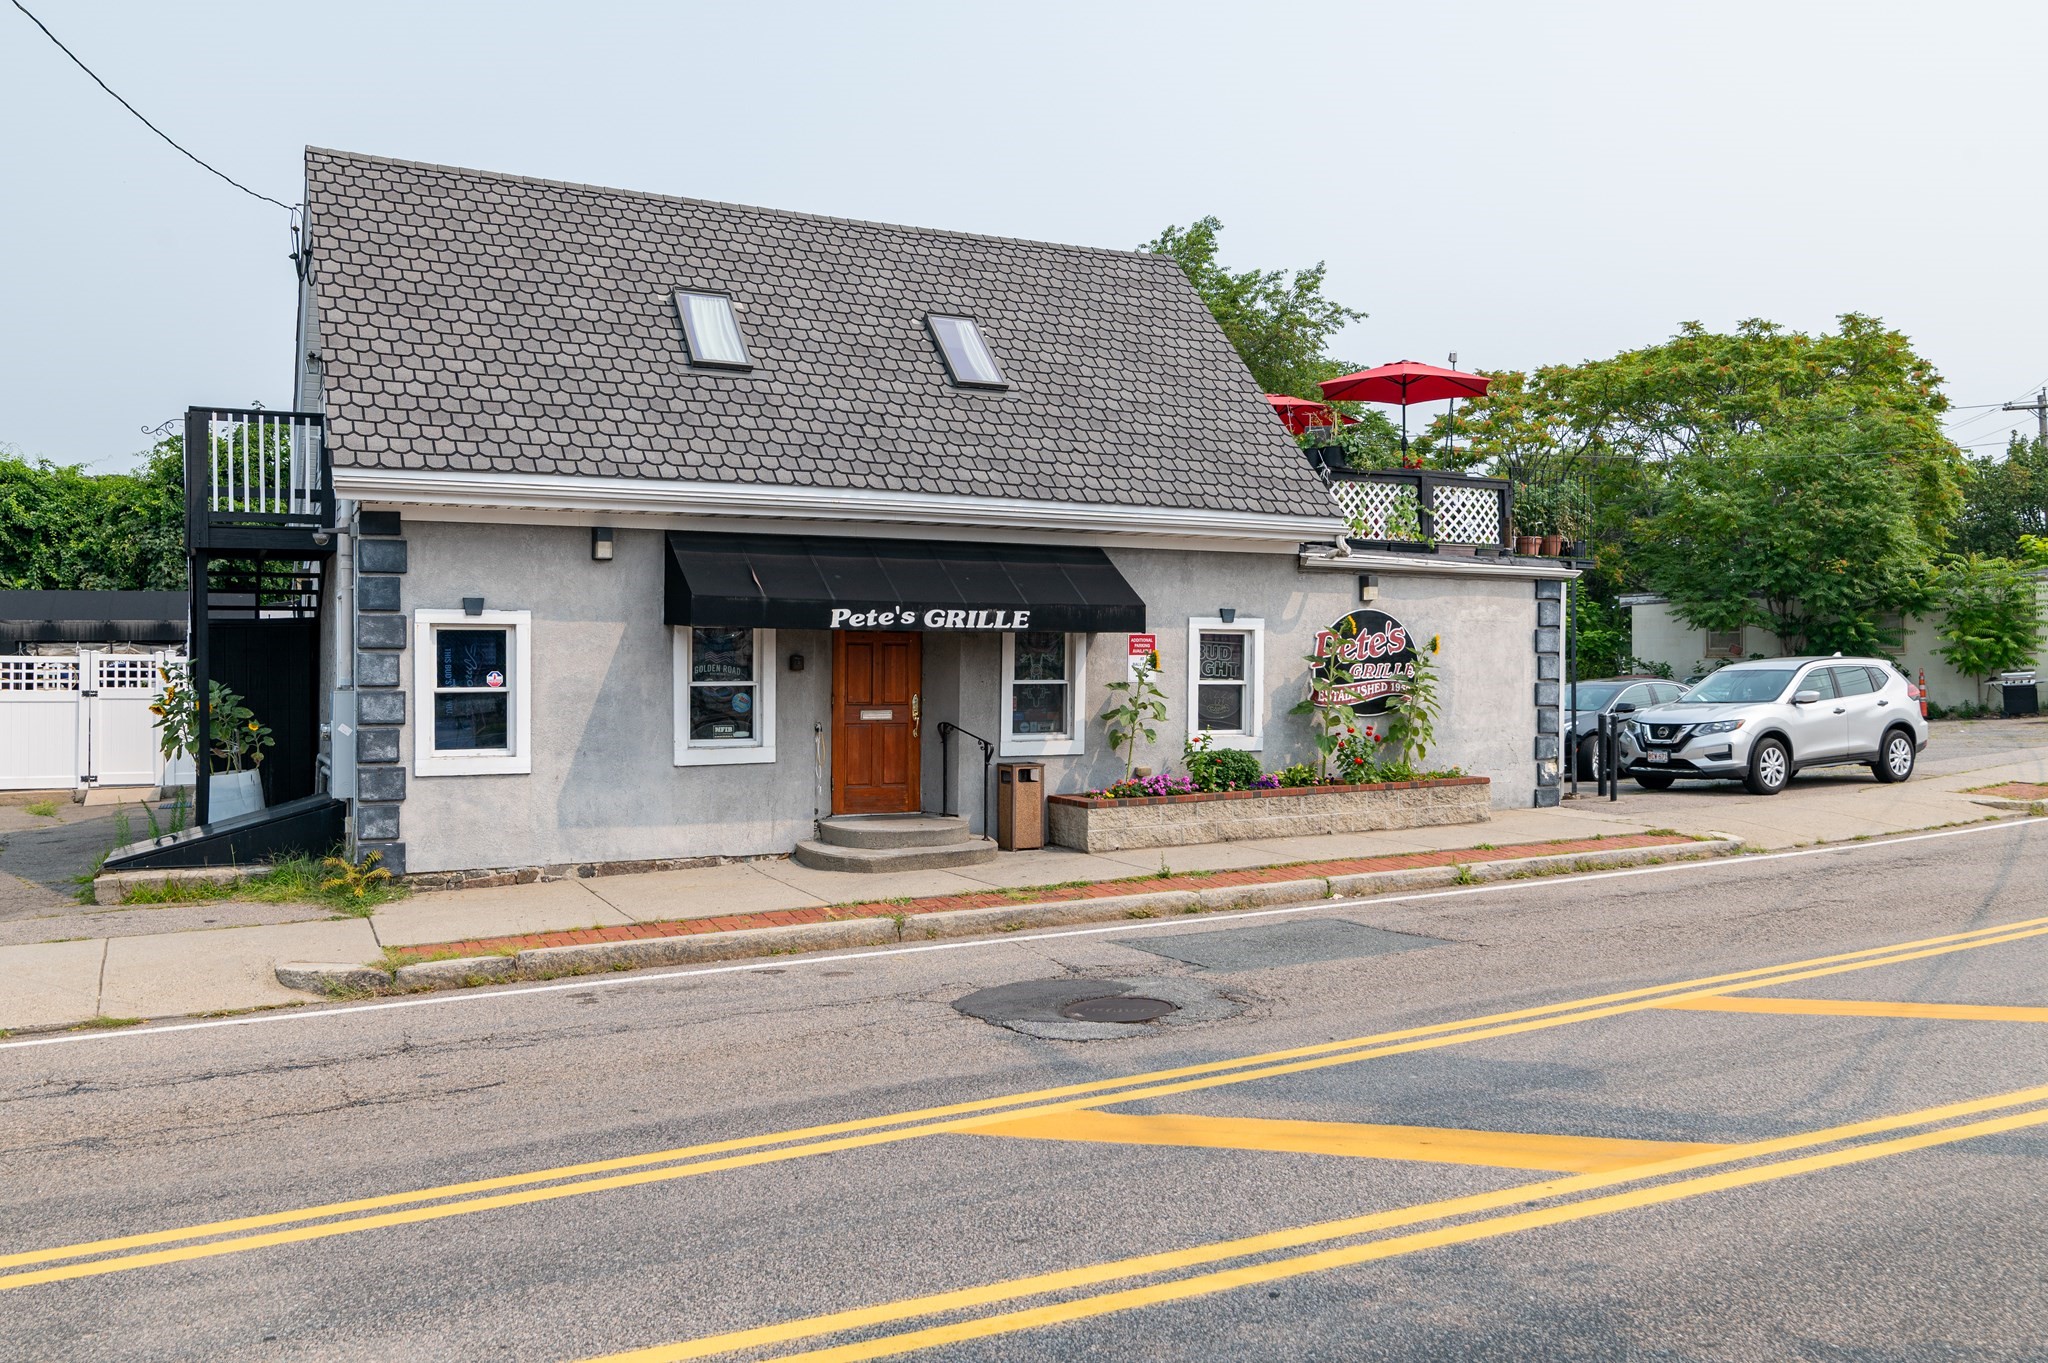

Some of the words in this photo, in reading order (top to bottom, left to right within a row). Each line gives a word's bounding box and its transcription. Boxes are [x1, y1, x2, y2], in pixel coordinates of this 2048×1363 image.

[830, 606, 915, 628] Pete's
[923, 609, 1031, 629] GRILLE
[1310, 620, 1406, 669] Pete's
[444, 648, 452, 664] THIS
[694, 664, 721, 674] GOLDEN
[722, 665, 741, 676] ROAD
[1201, 660, 1240, 677] GHT
[1350, 663, 1415, 679] GRILLE
